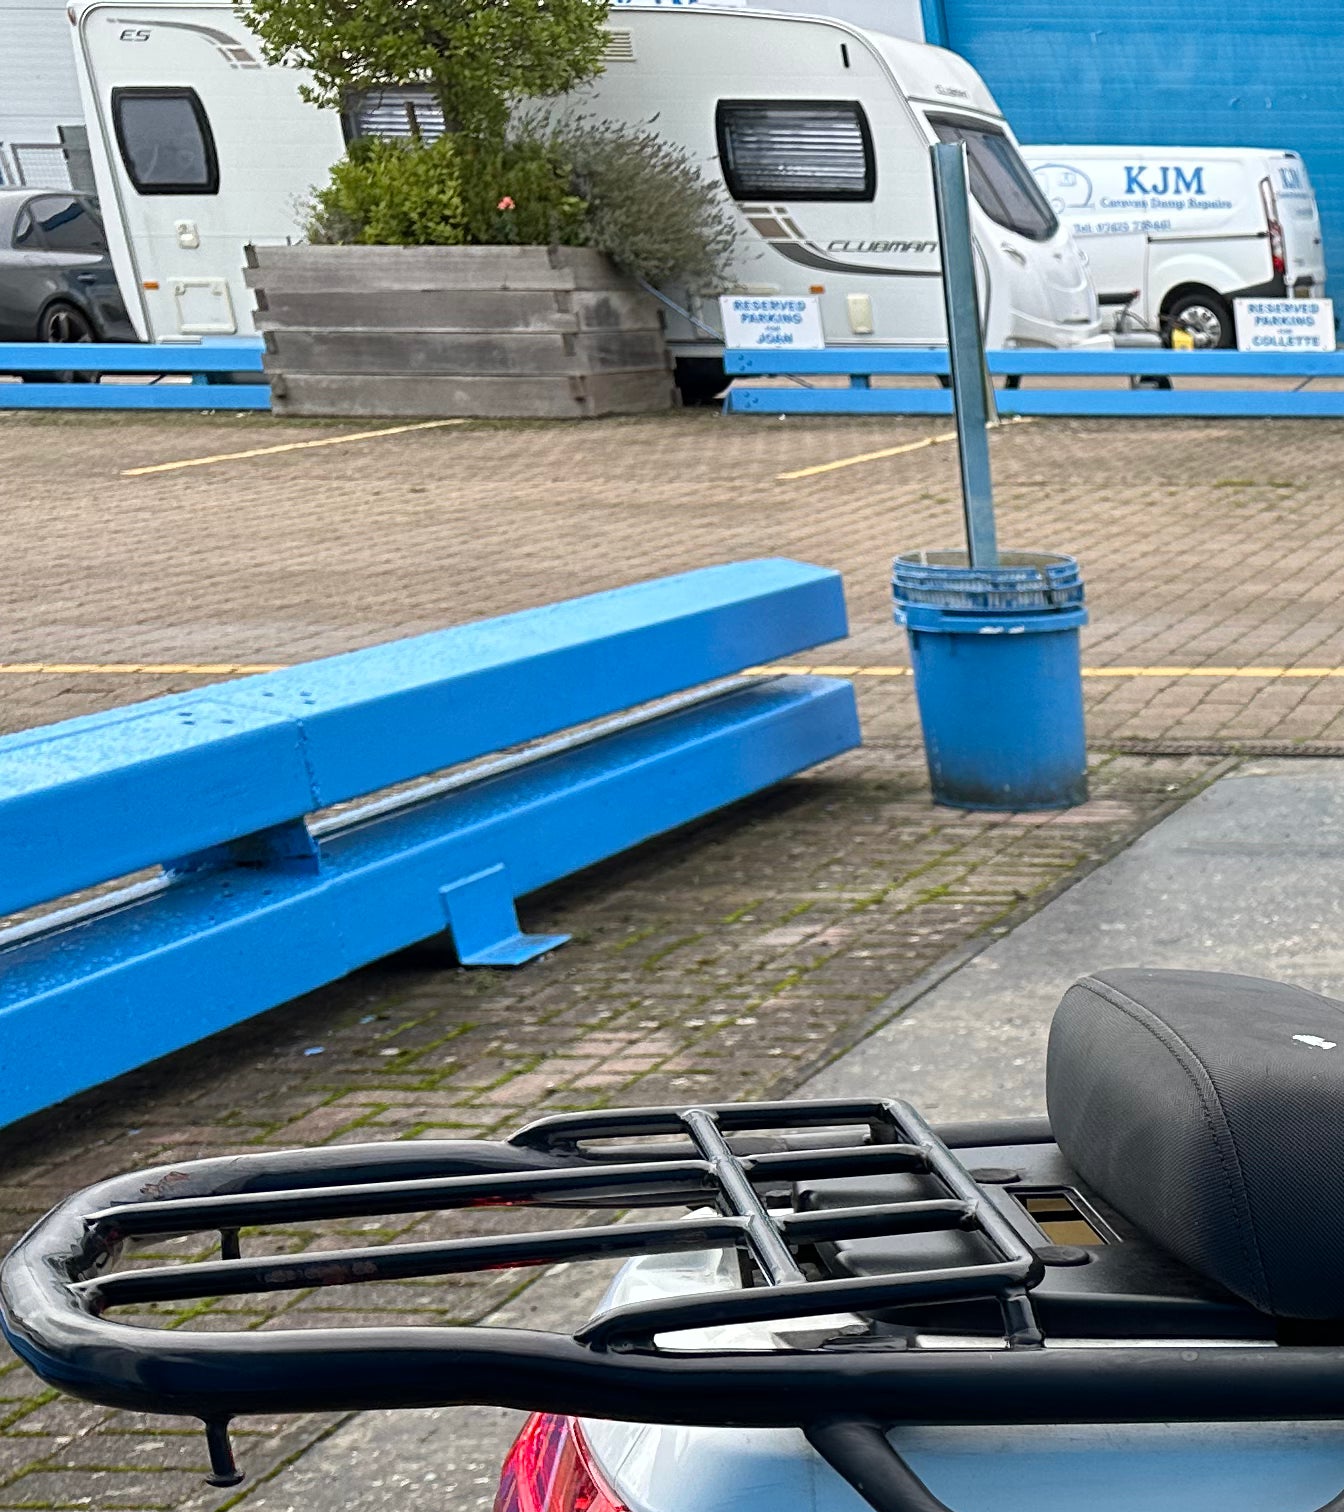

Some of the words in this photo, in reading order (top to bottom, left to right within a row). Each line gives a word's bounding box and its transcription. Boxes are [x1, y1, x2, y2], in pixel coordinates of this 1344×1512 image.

[1124, 165, 1206, 196] KJM
[1188, 199, 1232, 210] Repairs
[827, 240, 938, 253] CLUBMAN
[733, 300, 806, 312] RESERVED
[1247, 303, 1320, 314] RESERVED
[741, 313, 803, 325] PARKING
[1255, 316, 1315, 326] PARKING
[757, 332, 794, 344] JOAN
[1252, 335, 1320, 347] COLLETTE
